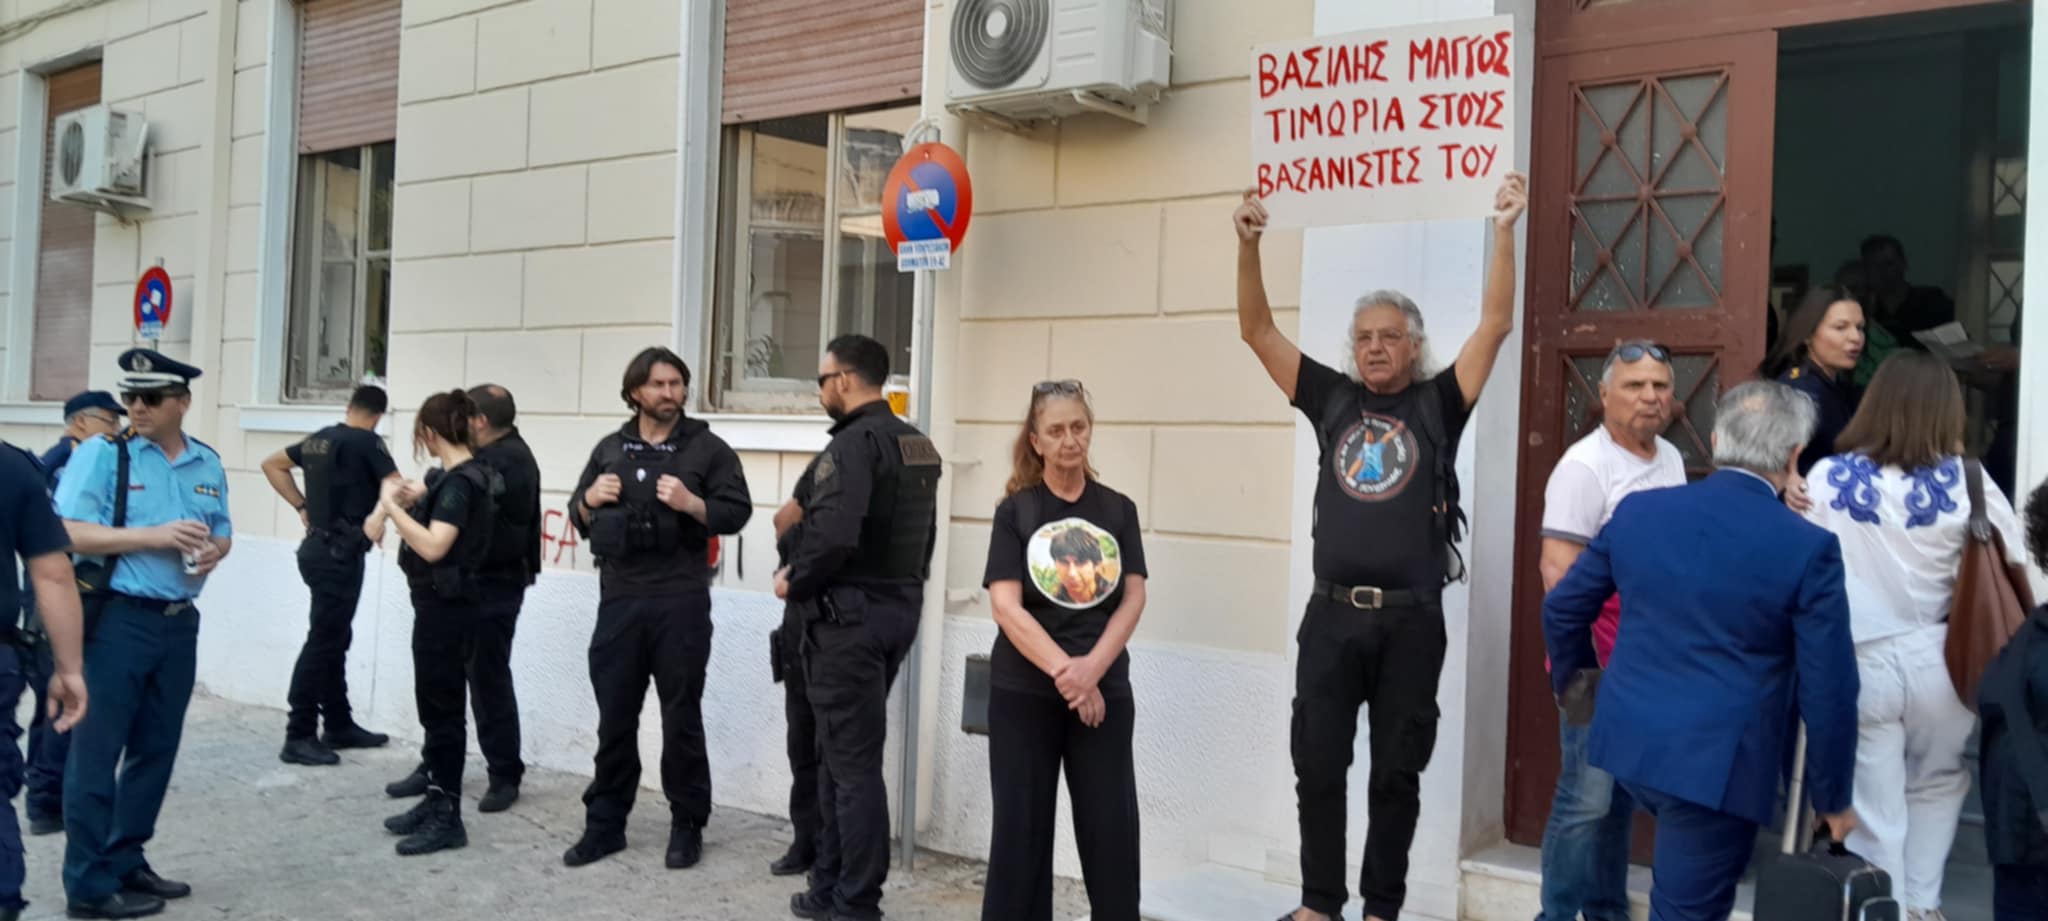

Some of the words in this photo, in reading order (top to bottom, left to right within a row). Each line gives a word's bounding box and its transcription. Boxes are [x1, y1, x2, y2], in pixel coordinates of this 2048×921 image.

[1258, 40, 1389, 99] ΒΑΣΙΛΗΣ
[1408, 31, 1511, 82] ΜΑΓΓΟΣ
[1264, 97, 1405, 144] ΤΙΜΩΡΙΑ
[1418, 90, 1505, 130] ΣΤΟΥΣ
[1257, 145, 1423, 200] ΒΑΣΑΝΙΣΤΕΣ
[1438, 143, 1498, 181] ΤΟΥ
